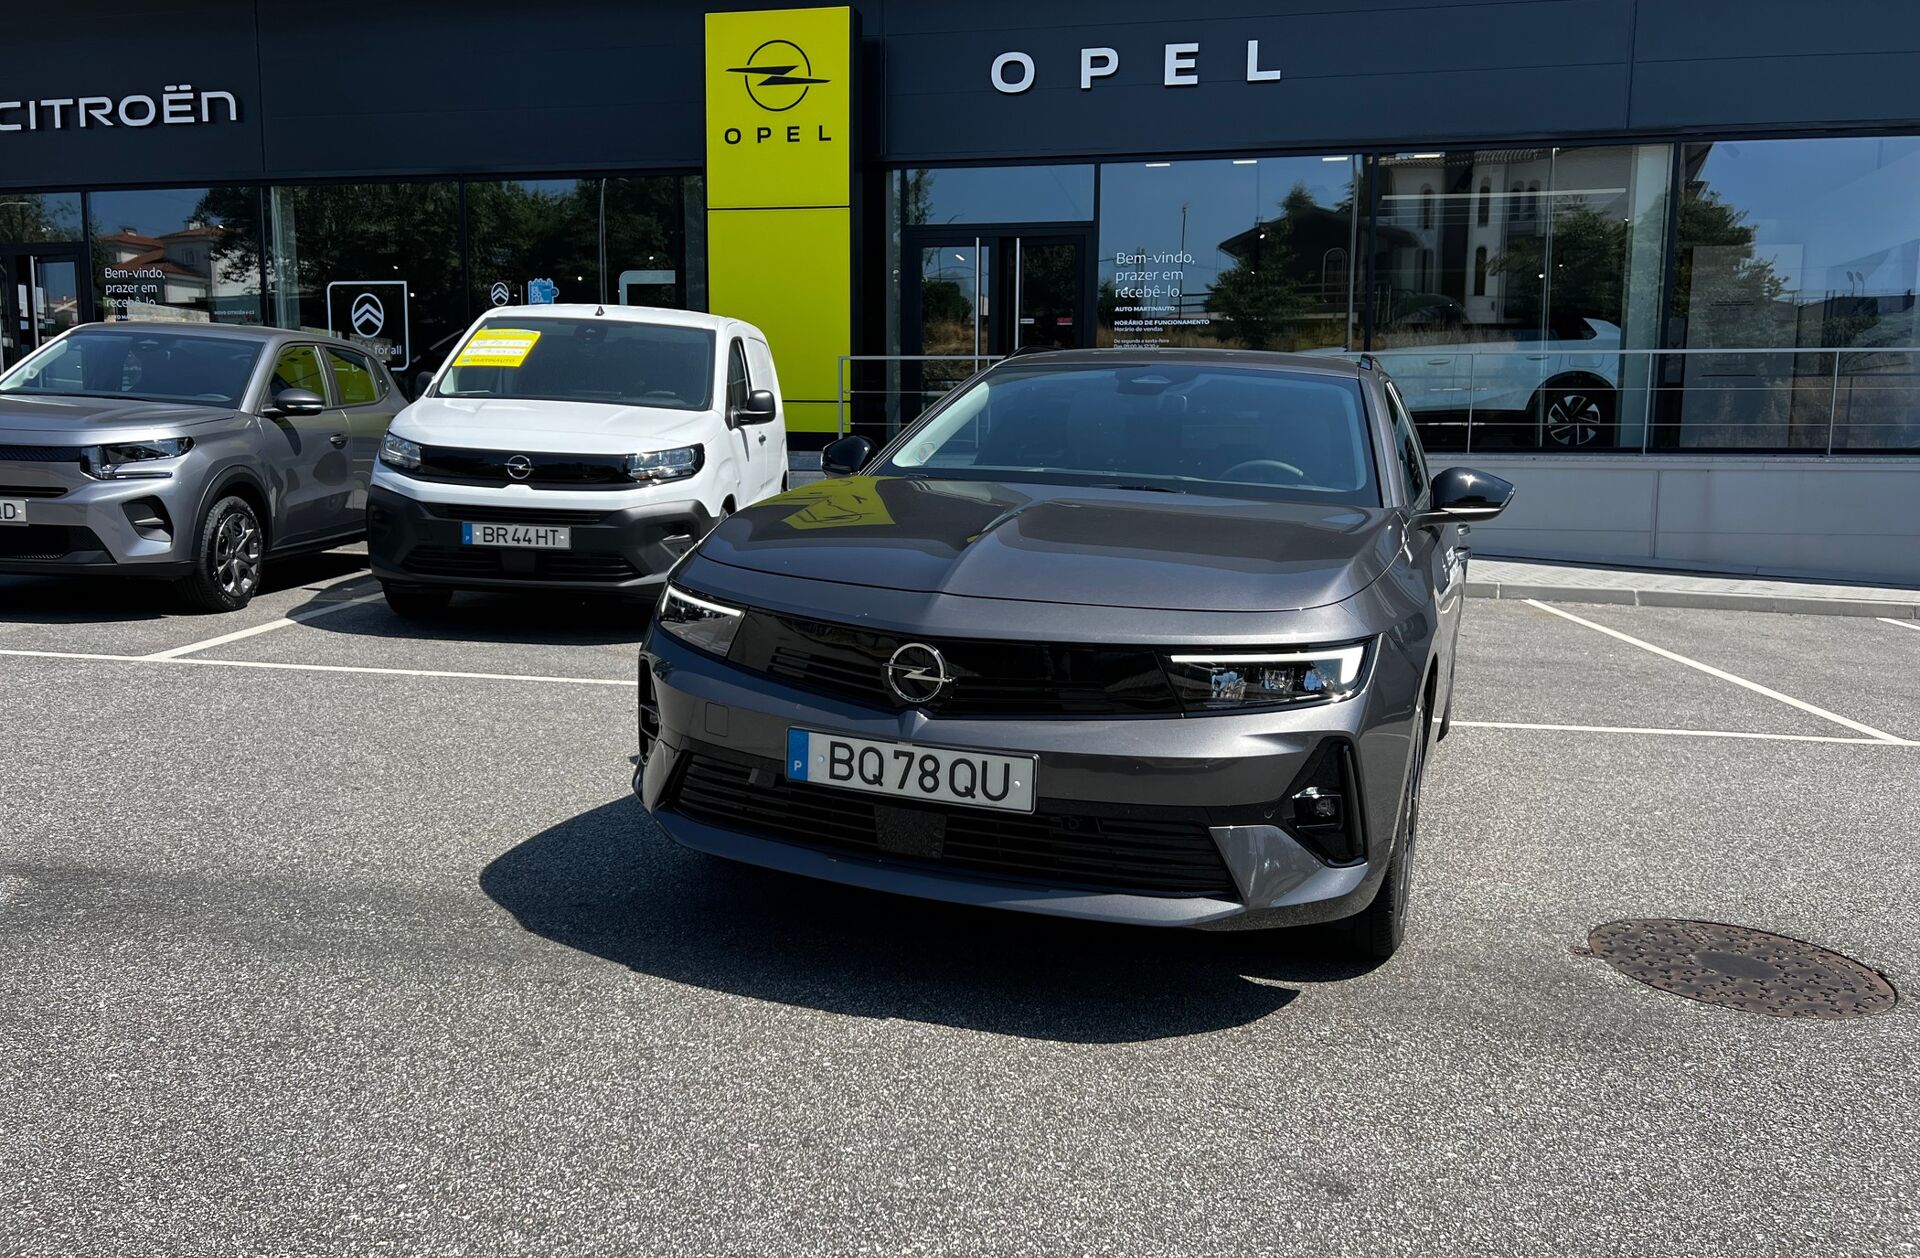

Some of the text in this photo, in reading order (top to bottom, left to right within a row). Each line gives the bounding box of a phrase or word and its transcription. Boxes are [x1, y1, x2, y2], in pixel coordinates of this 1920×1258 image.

[990, 39, 1281, 94] OPEL
[724, 124, 832, 145] OPEL
[1116, 250, 1195, 265] Bem-vindo,
[104, 267, 166, 280] Bem-vindo,
[1115, 270, 1184, 284] prazer em
[105, 283, 158, 295] prazer em
[1115, 284, 1183, 298] recebê-lo.
[374, 345, 402, 355] for all
[0, 503, 16, 520] D
[483, 526, 508, 544] BR
[511, 527, 532, 544] 44
[535, 528, 559, 546] HT
[793, 740, 1010, 802] P BQ 78 QU
